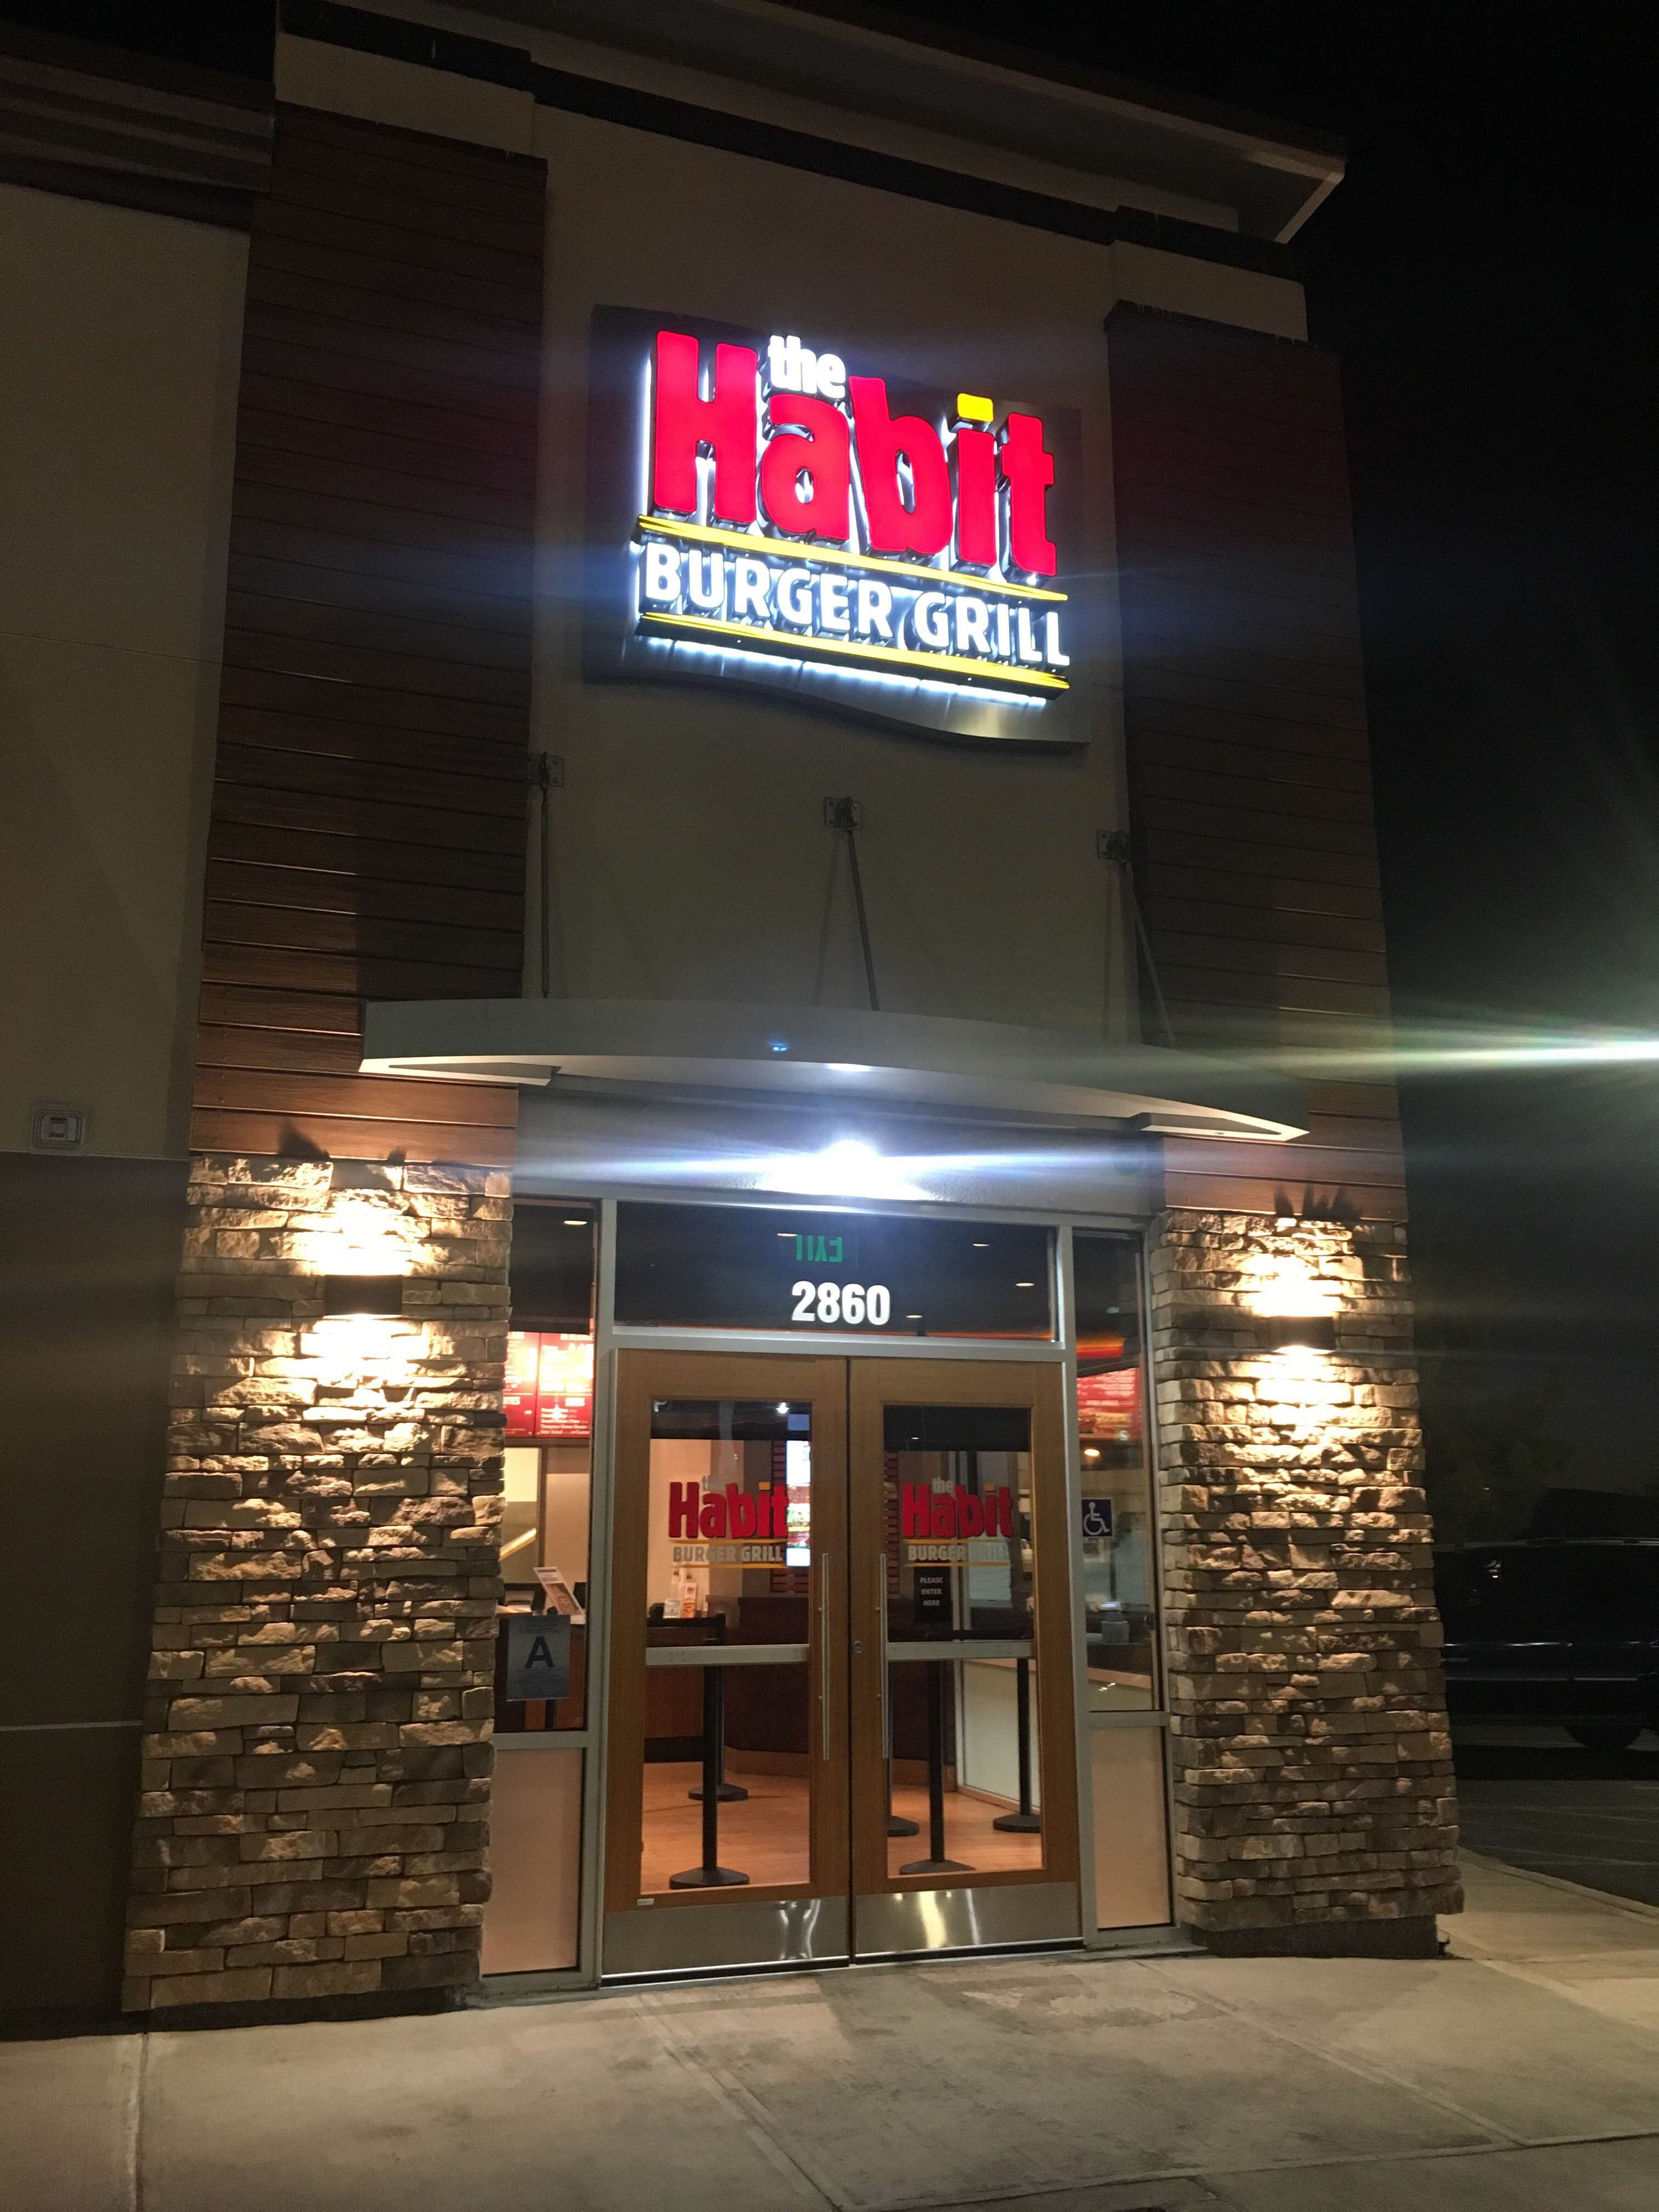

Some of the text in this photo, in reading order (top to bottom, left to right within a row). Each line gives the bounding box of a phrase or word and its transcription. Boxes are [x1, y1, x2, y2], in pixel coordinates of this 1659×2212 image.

[769, 336, 846, 398] the
[654, 330, 1057, 576] Habit
[645, 541, 1070, 666] BURGER GRILL
[792, 1280, 890, 1325] 2860
[668, 1481, 789, 1539] Habit
[901, 1482, 1014, 1537] Habit
[673, 1545, 783, 1562] BURGER GRILL
[908, 1544, 968, 1561] BURGER
[525, 1635, 555, 1669] A
